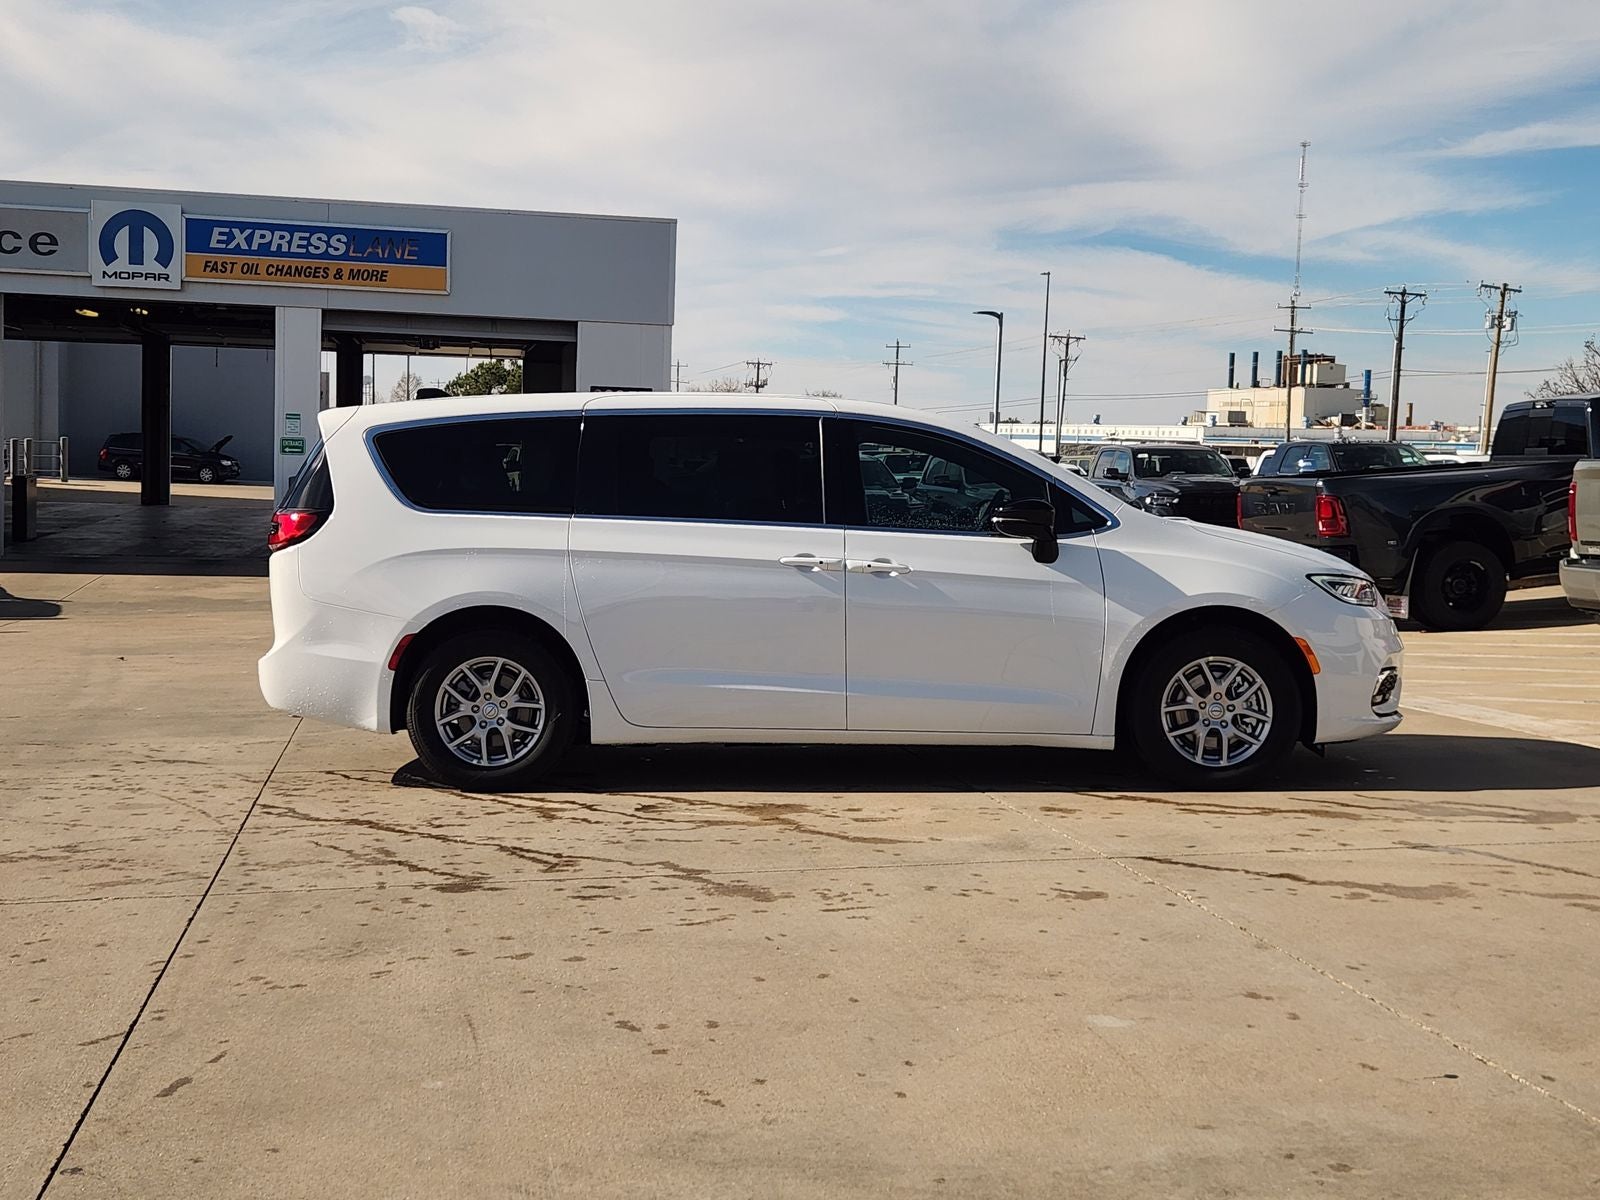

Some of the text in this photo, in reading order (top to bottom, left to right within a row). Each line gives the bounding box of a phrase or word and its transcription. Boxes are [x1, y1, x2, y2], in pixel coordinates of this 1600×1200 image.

[102, 270, 171, 282] MOPAR
[203, 260, 389, 282] FAST OIL CHANGES & MORE
